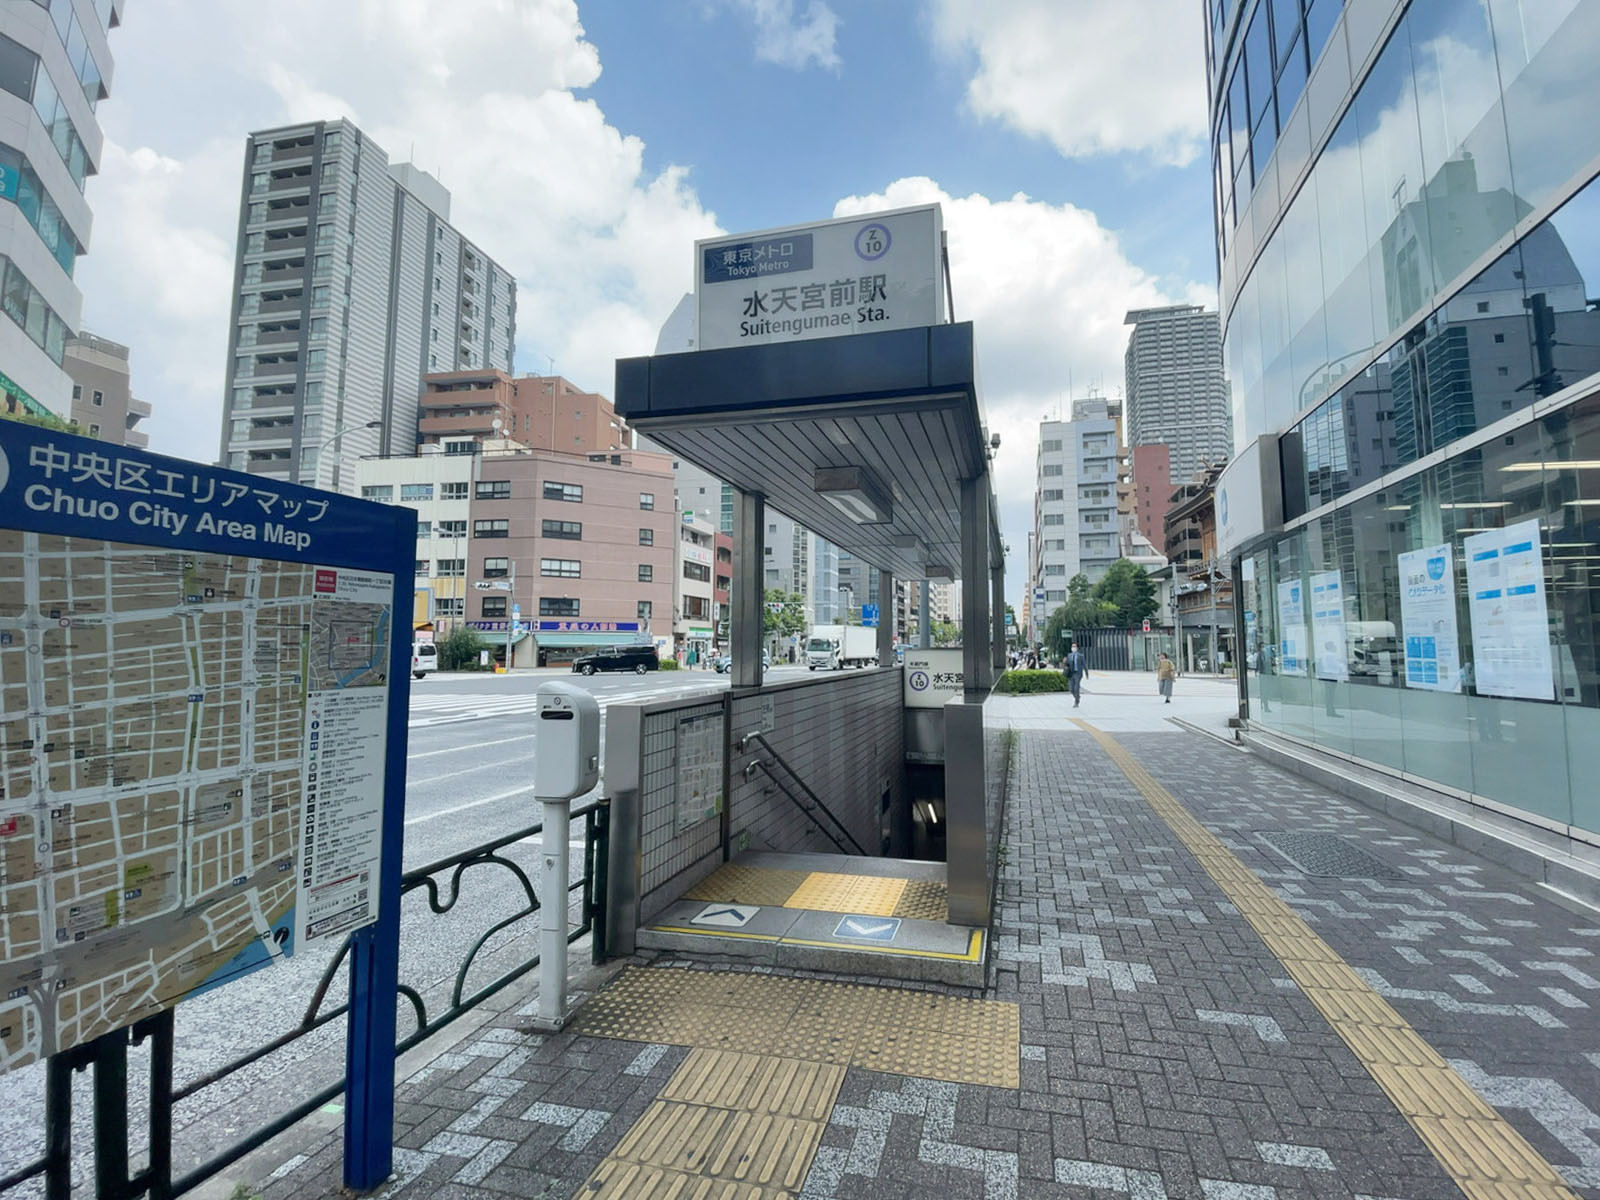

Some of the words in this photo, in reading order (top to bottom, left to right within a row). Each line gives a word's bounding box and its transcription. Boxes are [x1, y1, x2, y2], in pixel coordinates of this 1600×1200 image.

[865, 241, 882, 254] 10
[868, 230, 877, 241] Z
[722, 242, 794, 266] 東京メトロ
[727, 262, 757, 276] Tokyo
[758, 259, 789, 273] Metro
[743, 273, 887, 318] 水天宮前駅
[740, 312, 850, 337] Suitengumae
[857, 306, 890, 324] Sta.
[29, 442, 330, 522] 中央区エリアマップ
[24, 483, 120, 521] Chuo
[128, 501, 188, 536] City
[195, 513, 257, 541] Area
[263, 523, 311, 551] Map
